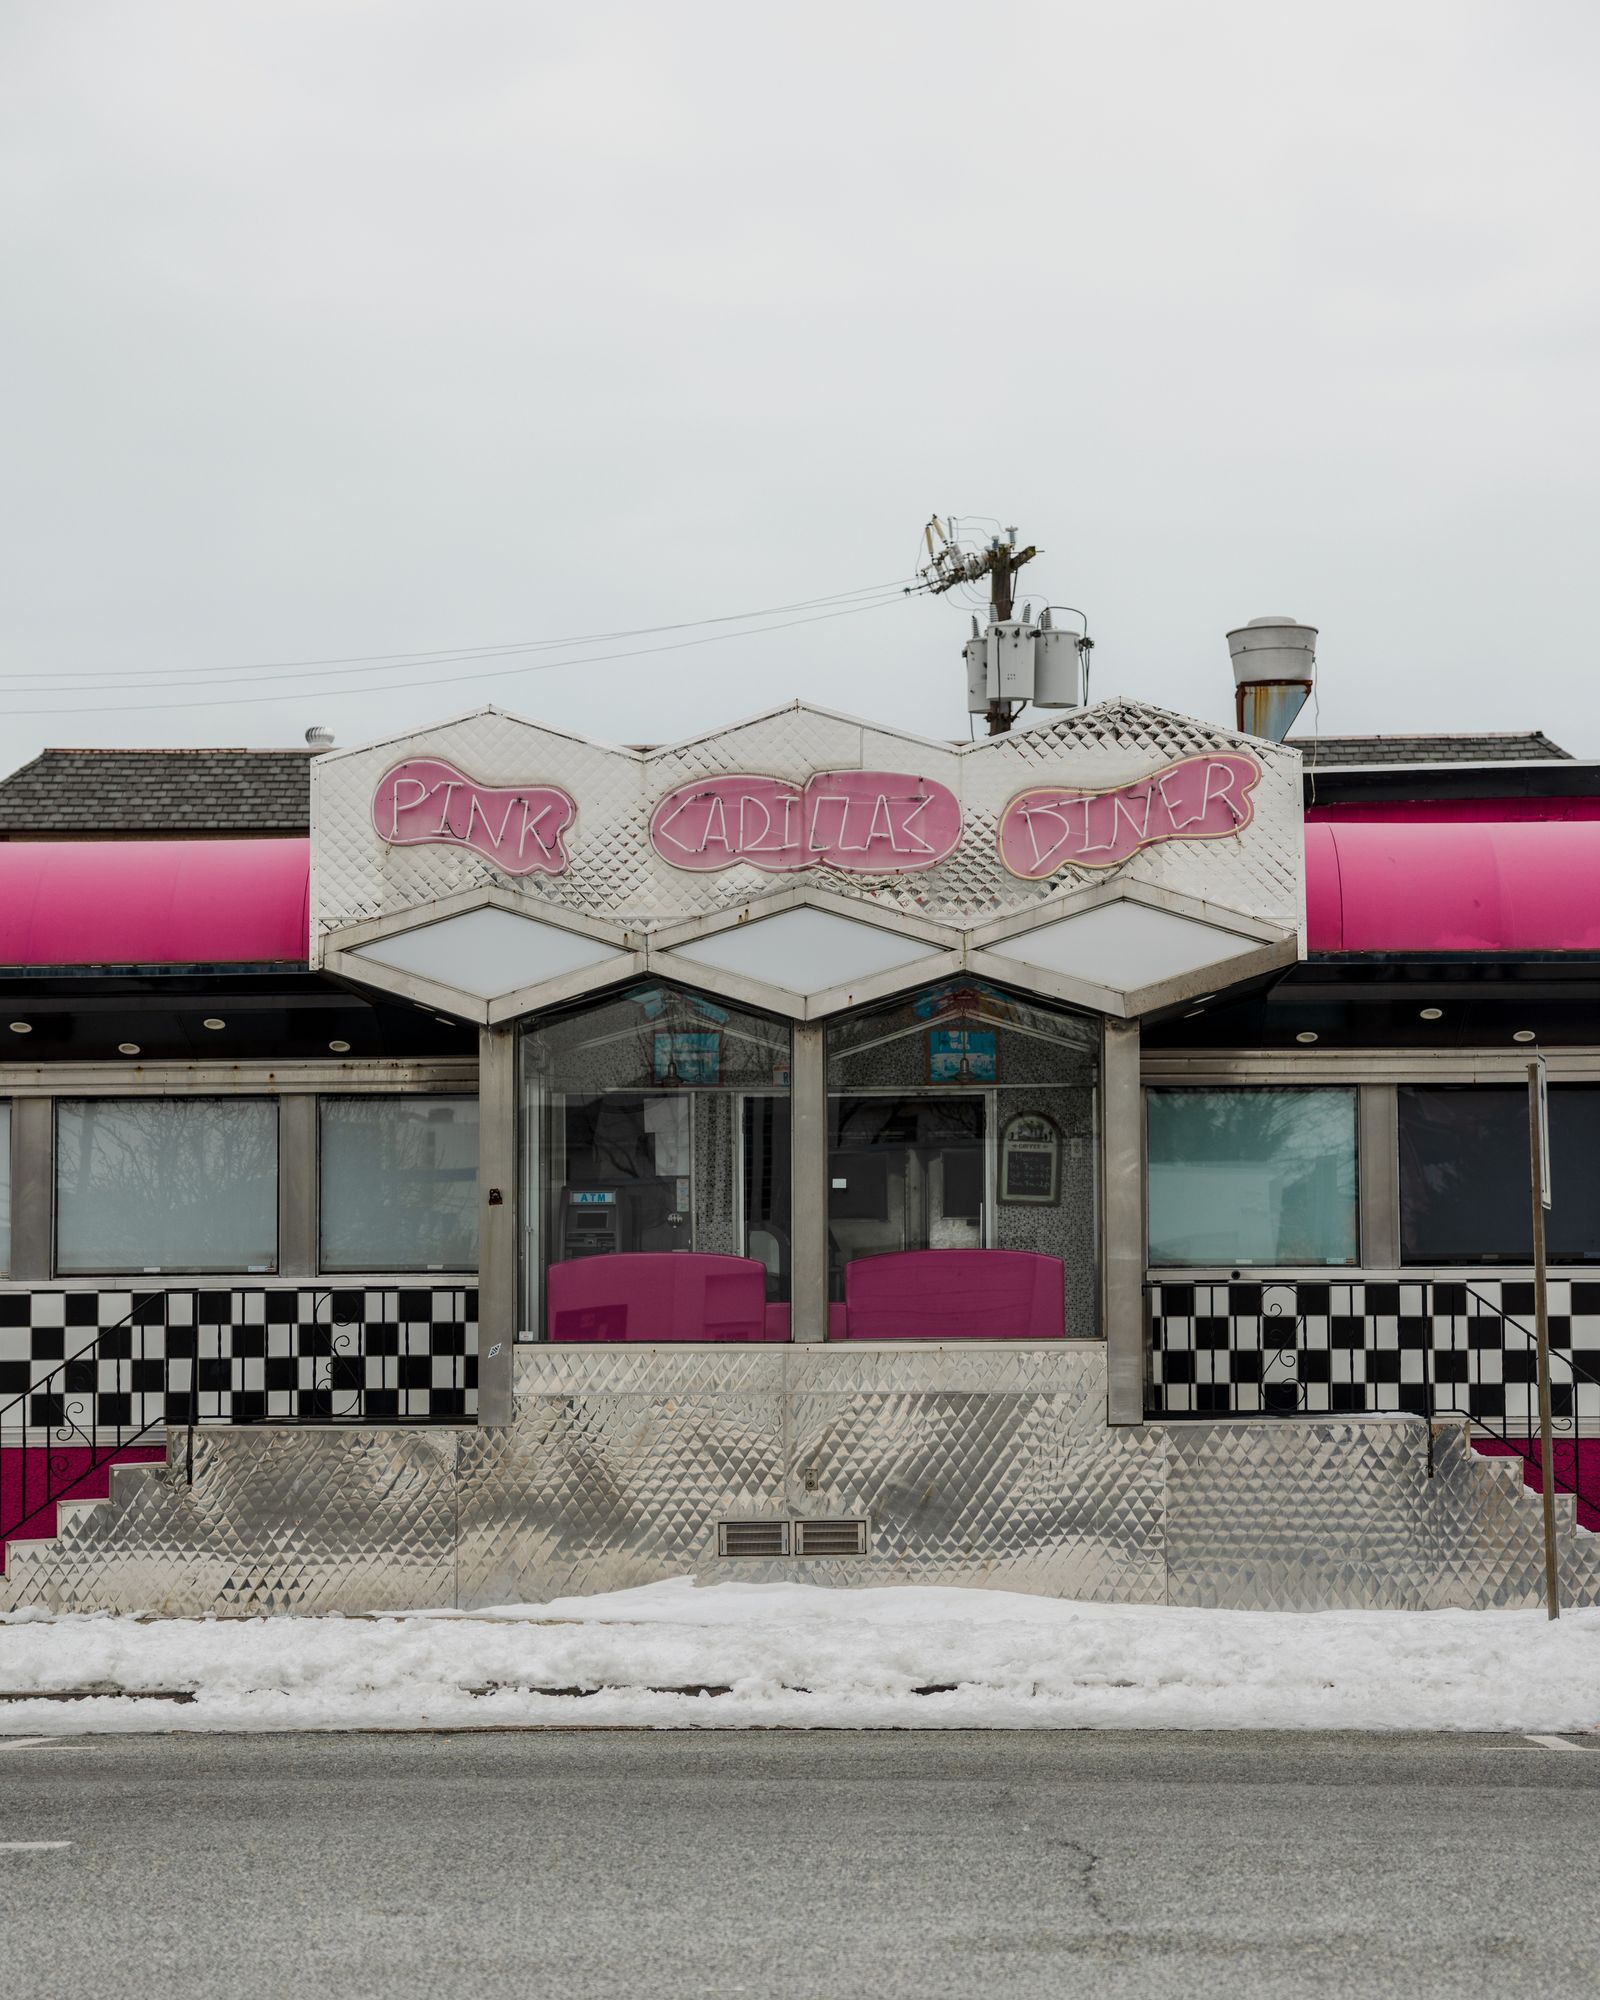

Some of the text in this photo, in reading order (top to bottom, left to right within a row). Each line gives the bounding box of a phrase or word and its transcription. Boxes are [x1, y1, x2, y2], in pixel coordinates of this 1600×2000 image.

[393, 763, 1244, 872] PINK CADILLAC DINER
[580, 1192, 606, 1202] ATM
